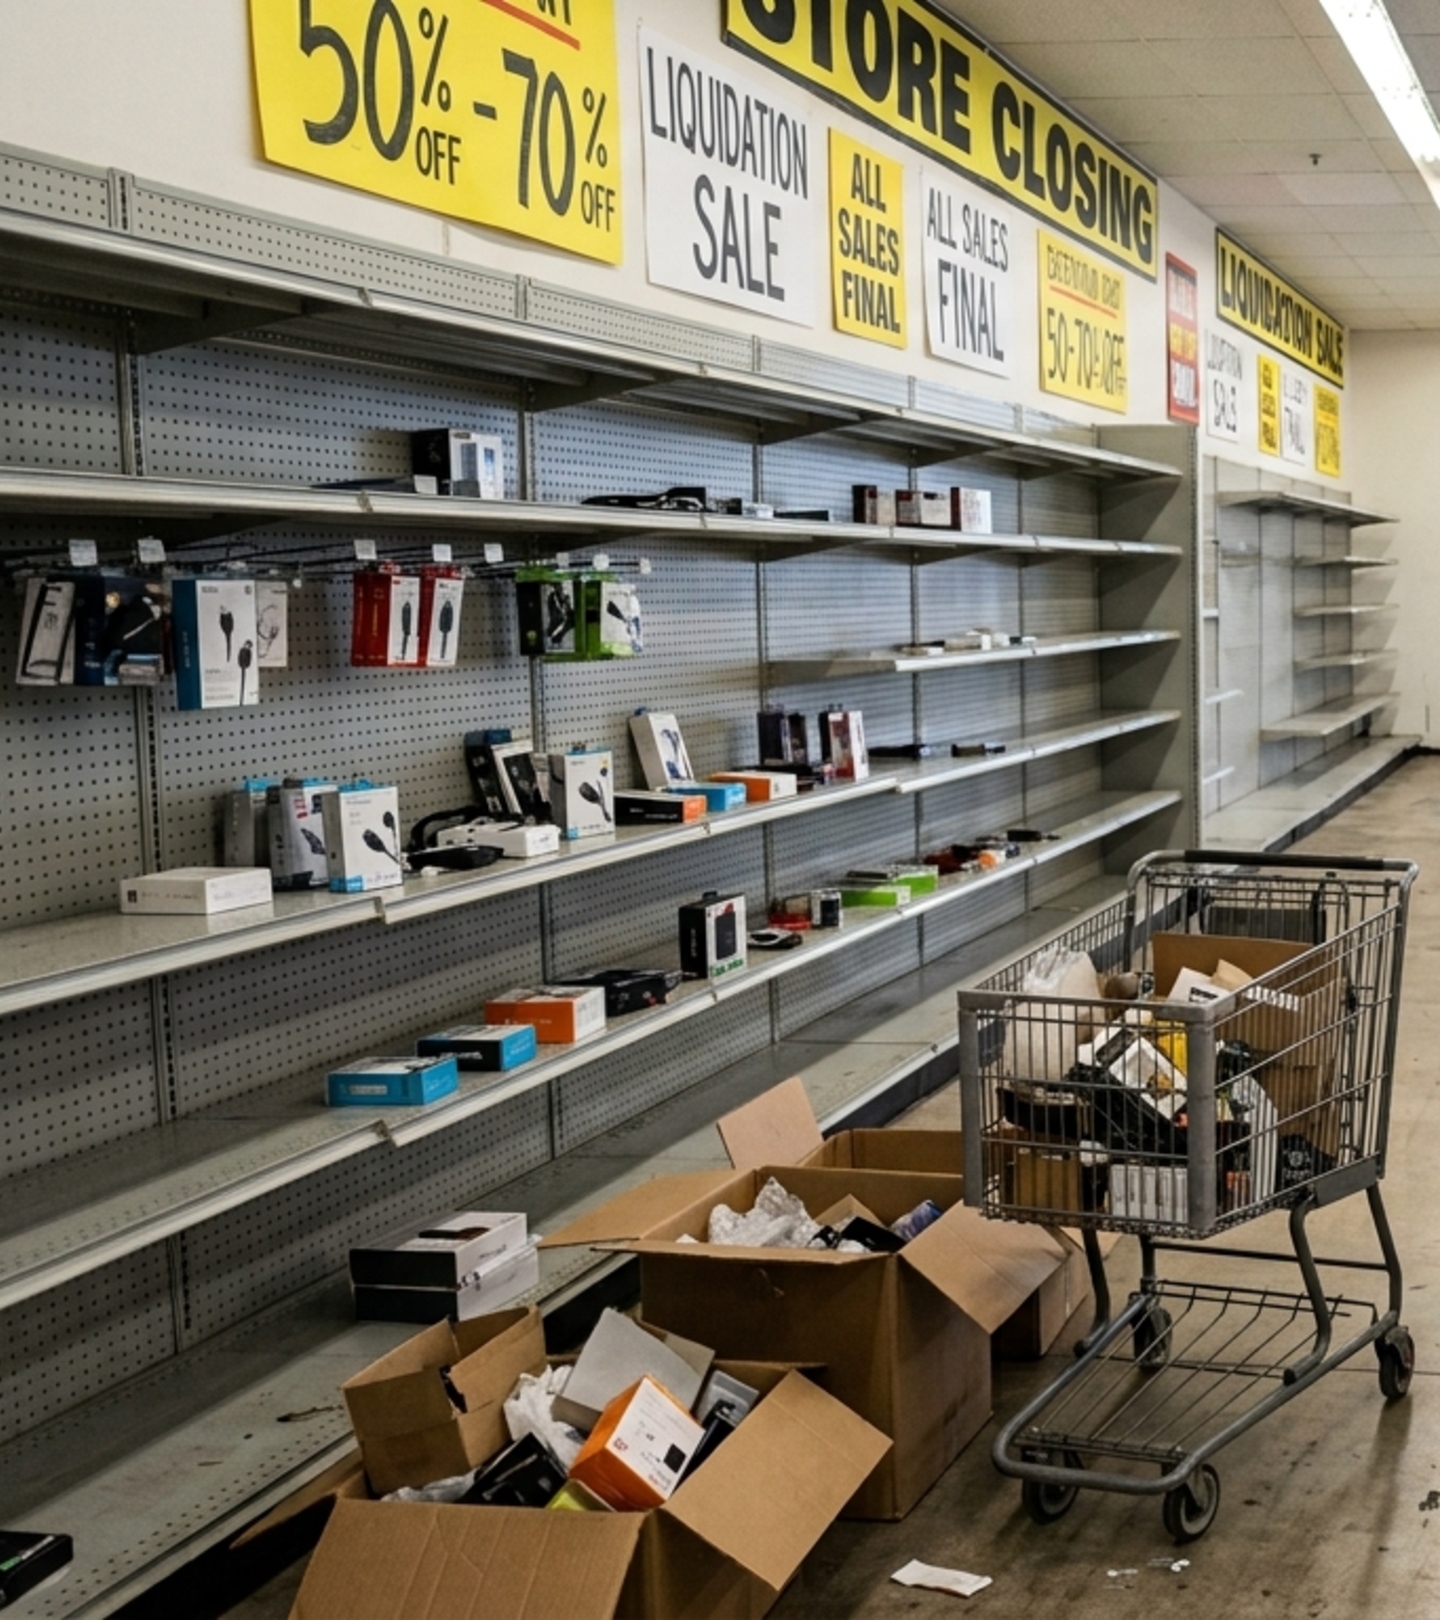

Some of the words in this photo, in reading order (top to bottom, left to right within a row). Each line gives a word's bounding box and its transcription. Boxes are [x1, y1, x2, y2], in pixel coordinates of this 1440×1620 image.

[301, 0, 451, 161] 50%
[646, 47, 809, 201] LIQUIDATION
[416, 126, 461, 186] OFF
[581, 181, 615, 233] OFF
[851, 152, 887, 214] ALL
[991, 80, 1154, 266] CLOSING
[692, 174, 786, 303] SALE
[838, 207, 899, 277] SALES
[927, 187, 957, 250] ALL
[963, 203, 1009, 273] SALES
[842, 269, 901, 334] FINAL
[938, 258, 1004, 363] FINAL
